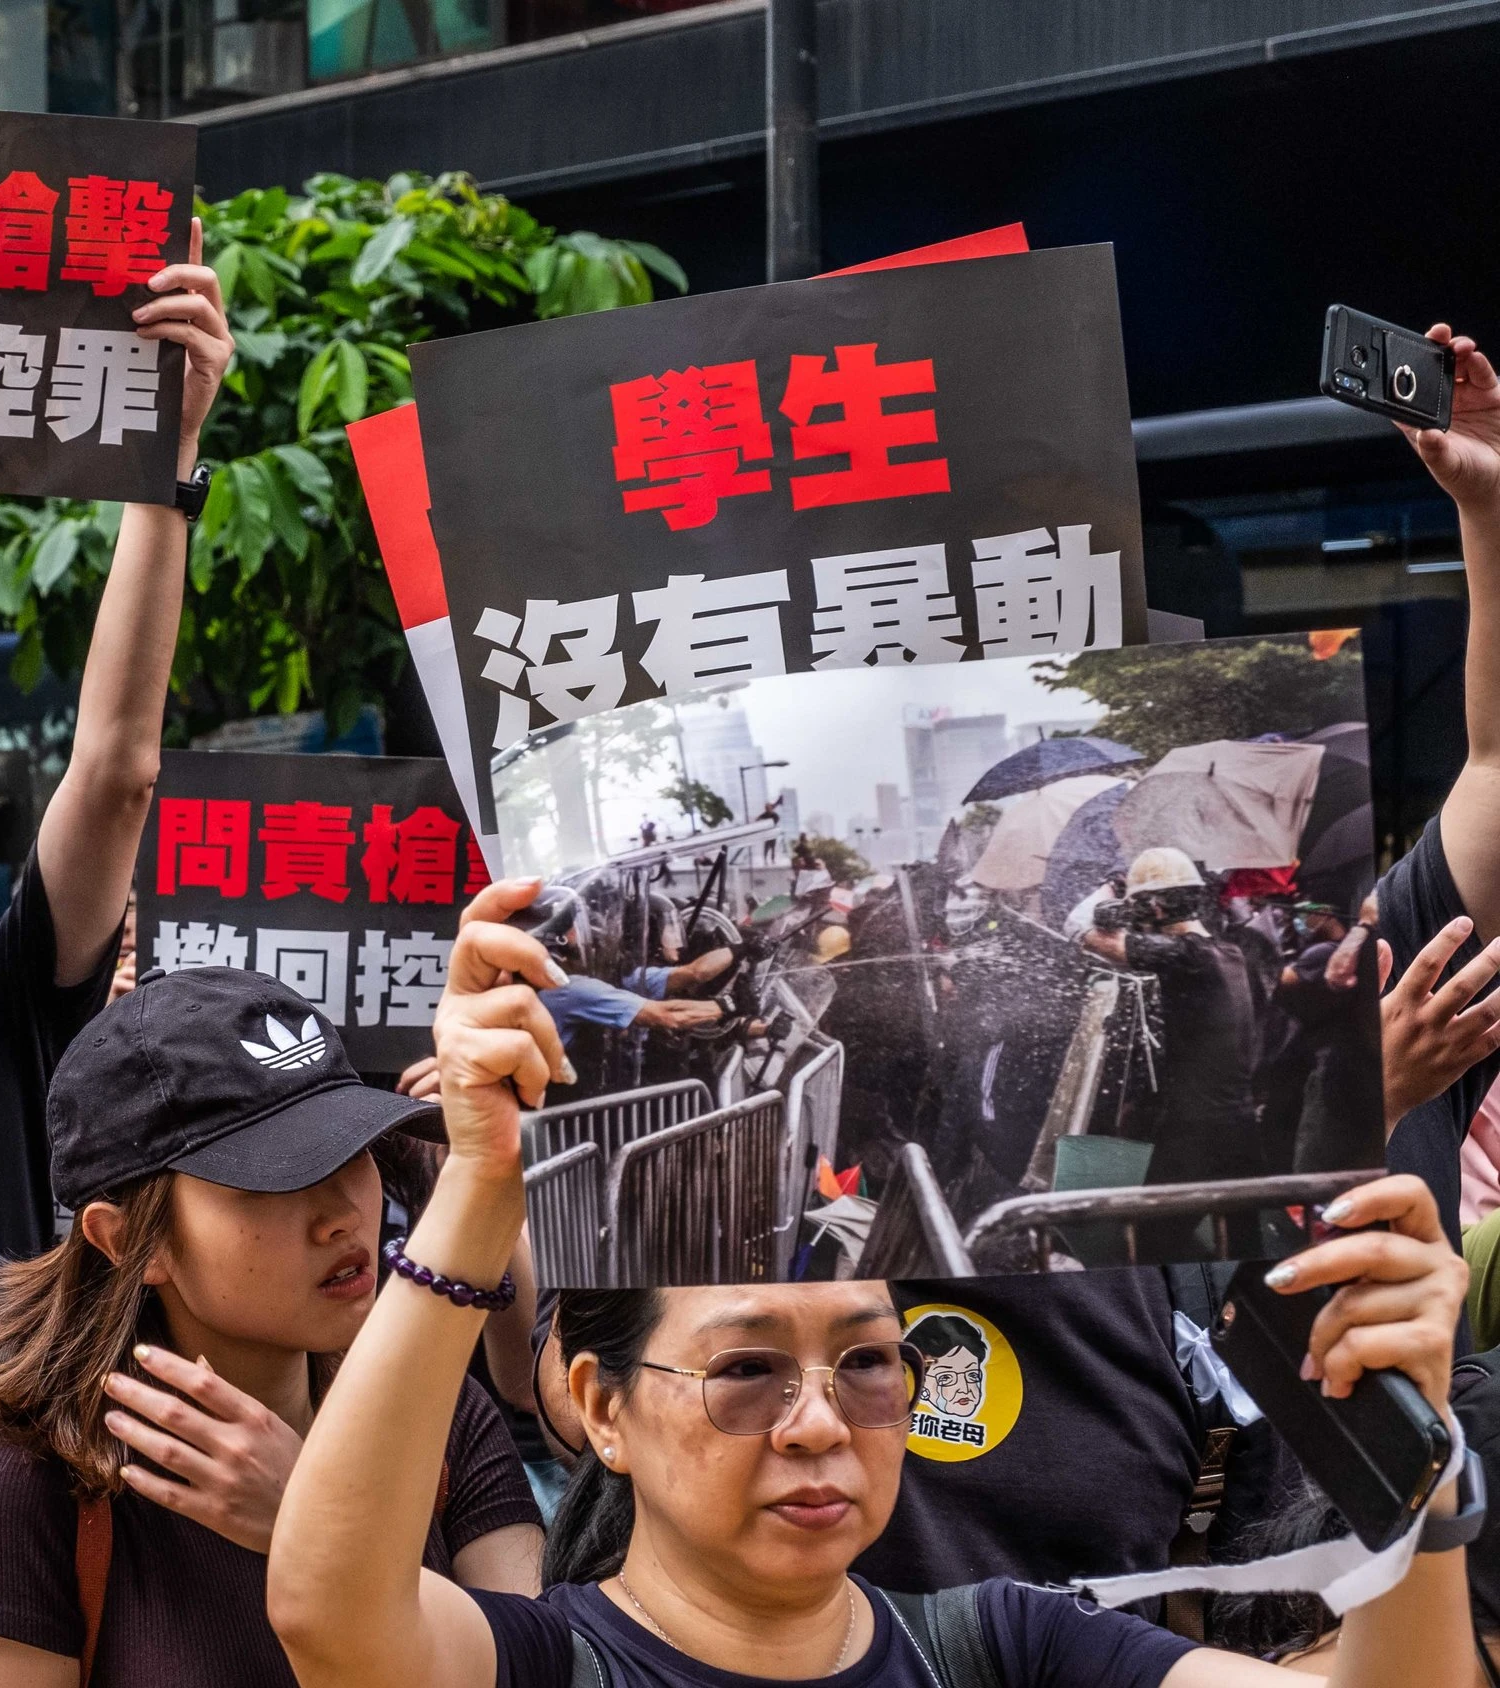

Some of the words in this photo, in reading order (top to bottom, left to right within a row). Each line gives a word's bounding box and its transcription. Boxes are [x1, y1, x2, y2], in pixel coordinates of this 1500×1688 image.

[611, 343, 951, 530] 學生
[474, 524, 1123, 750] 沒有暴動
[156, 797, 492, 905] 問責槍
